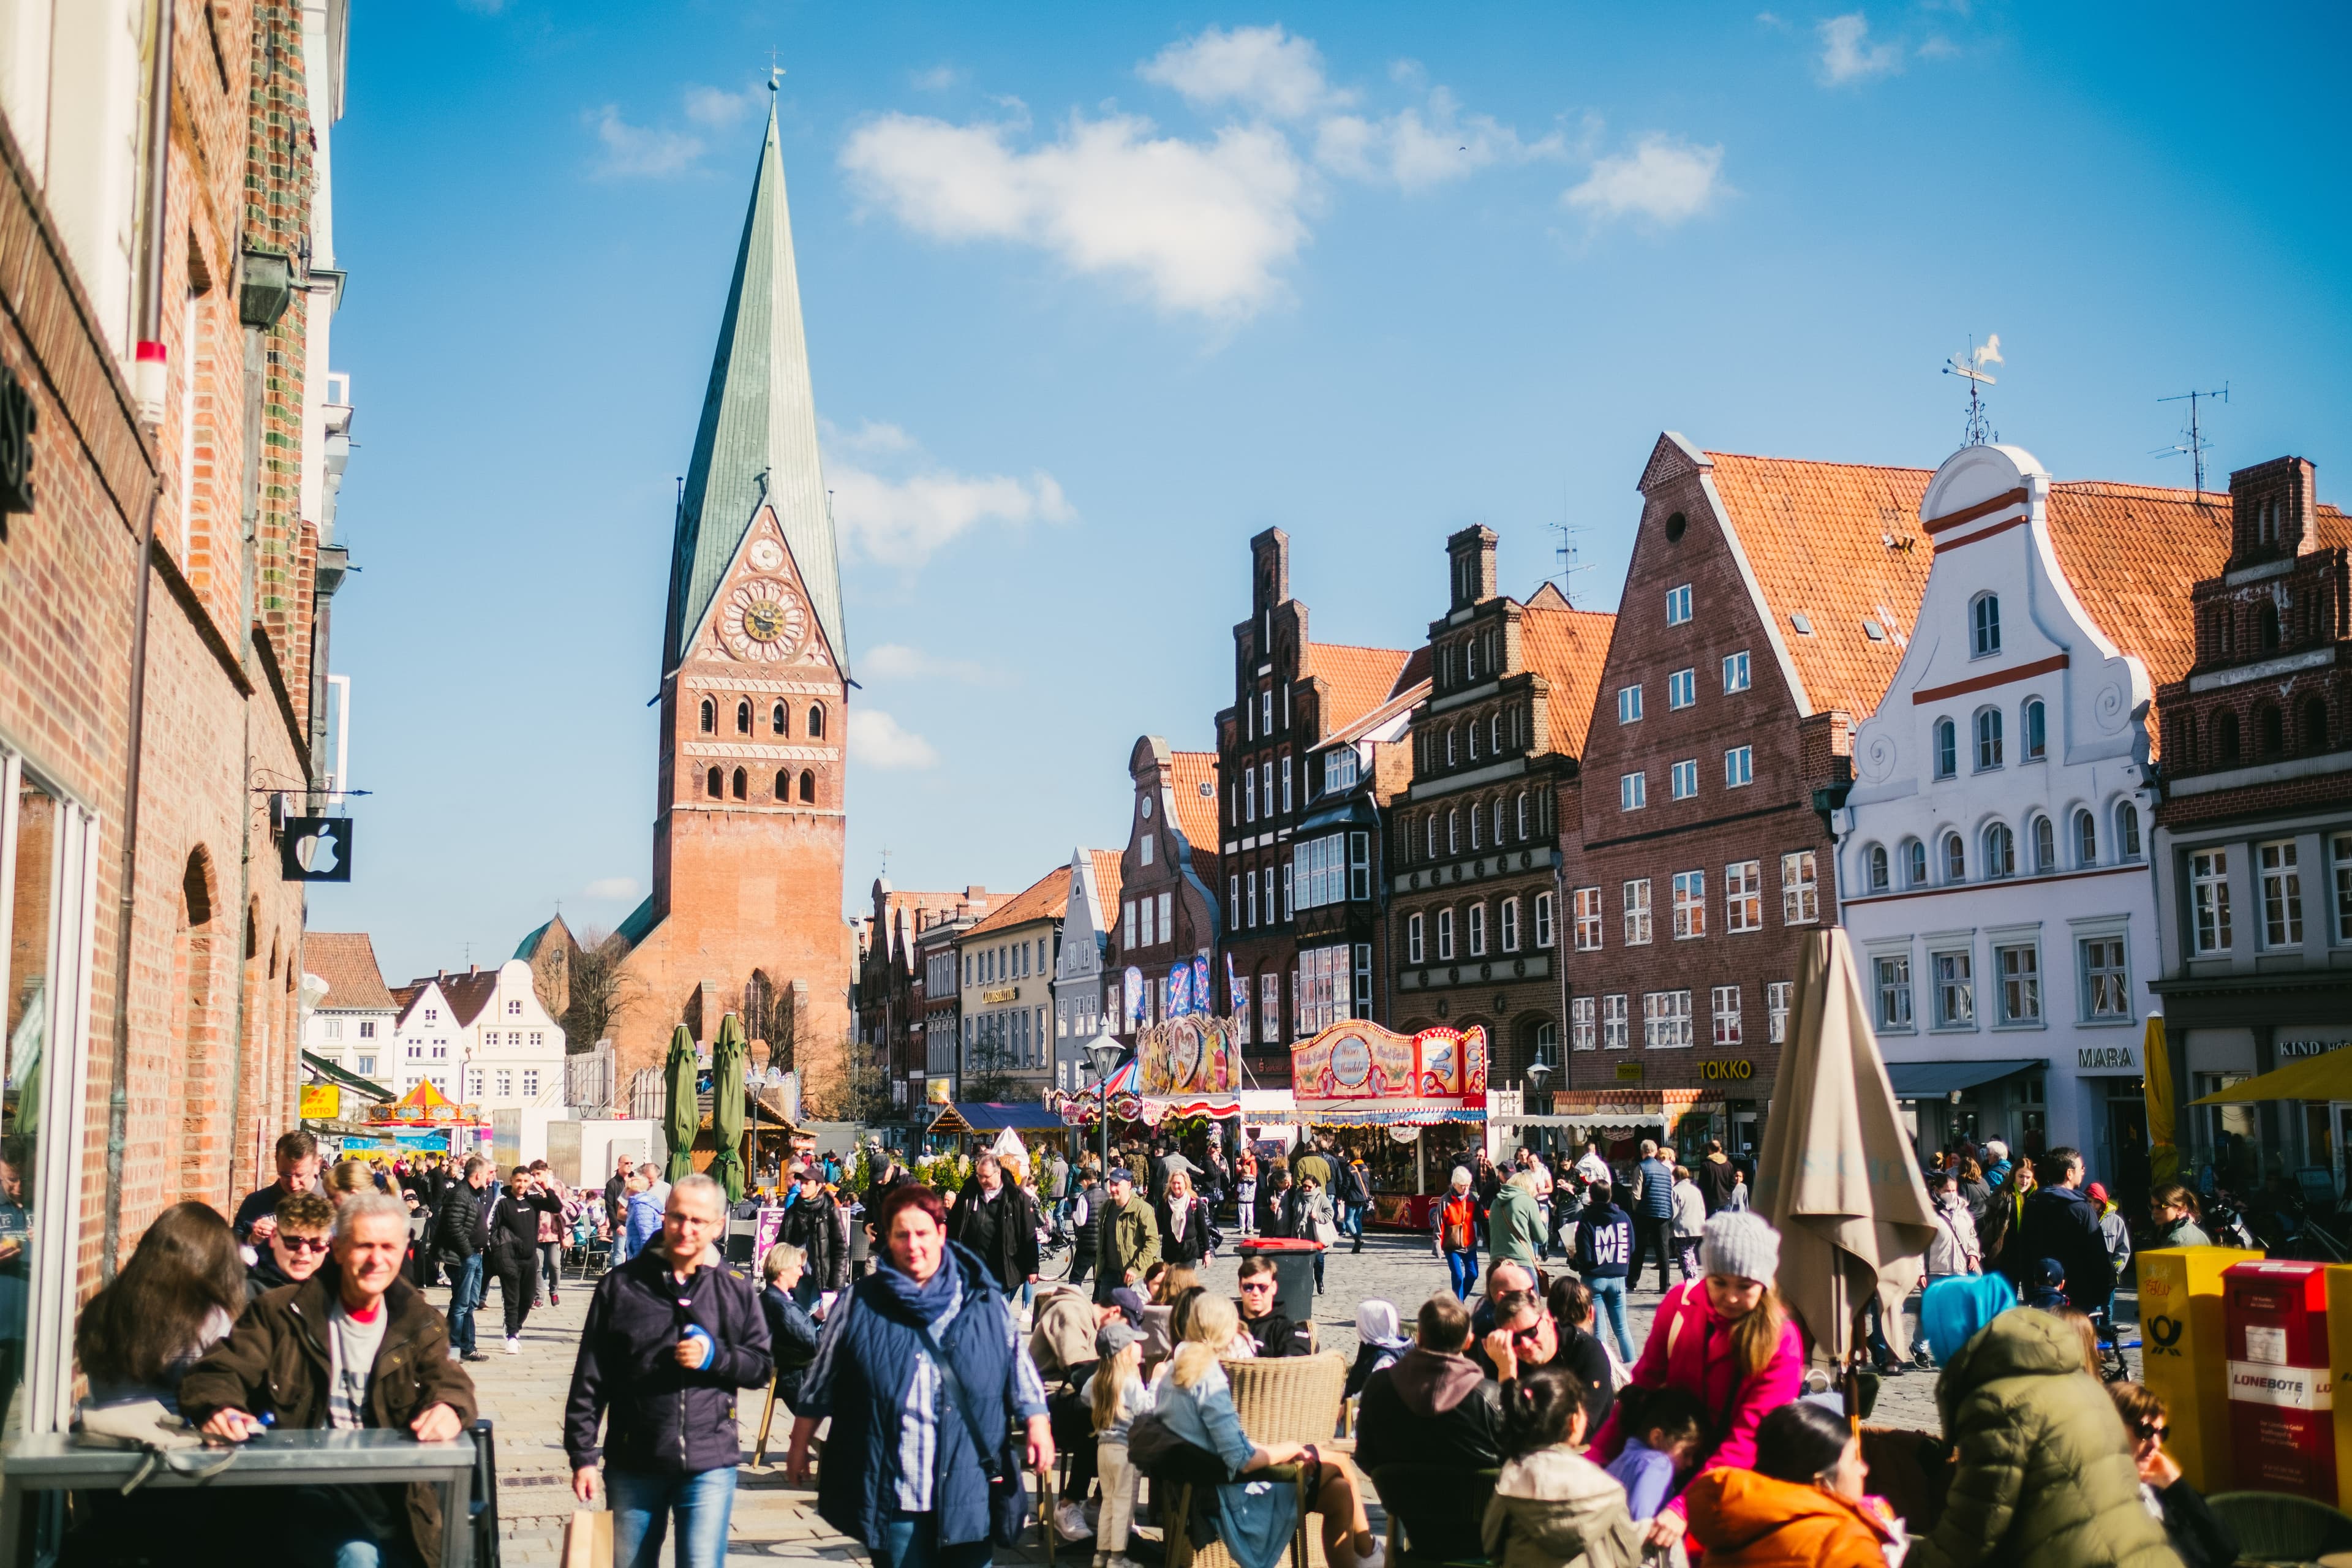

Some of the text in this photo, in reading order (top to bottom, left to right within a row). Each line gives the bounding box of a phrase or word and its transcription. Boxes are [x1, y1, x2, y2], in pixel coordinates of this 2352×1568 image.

[2078, 1047, 2134, 1067] MARA
[2279, 1041, 2320, 1055] KIND
[1338, 1061, 1363, 1072] Mandeln
[1596, 1223, 1628, 1246] ME
[1595, 1243, 1628, 1265] WE
